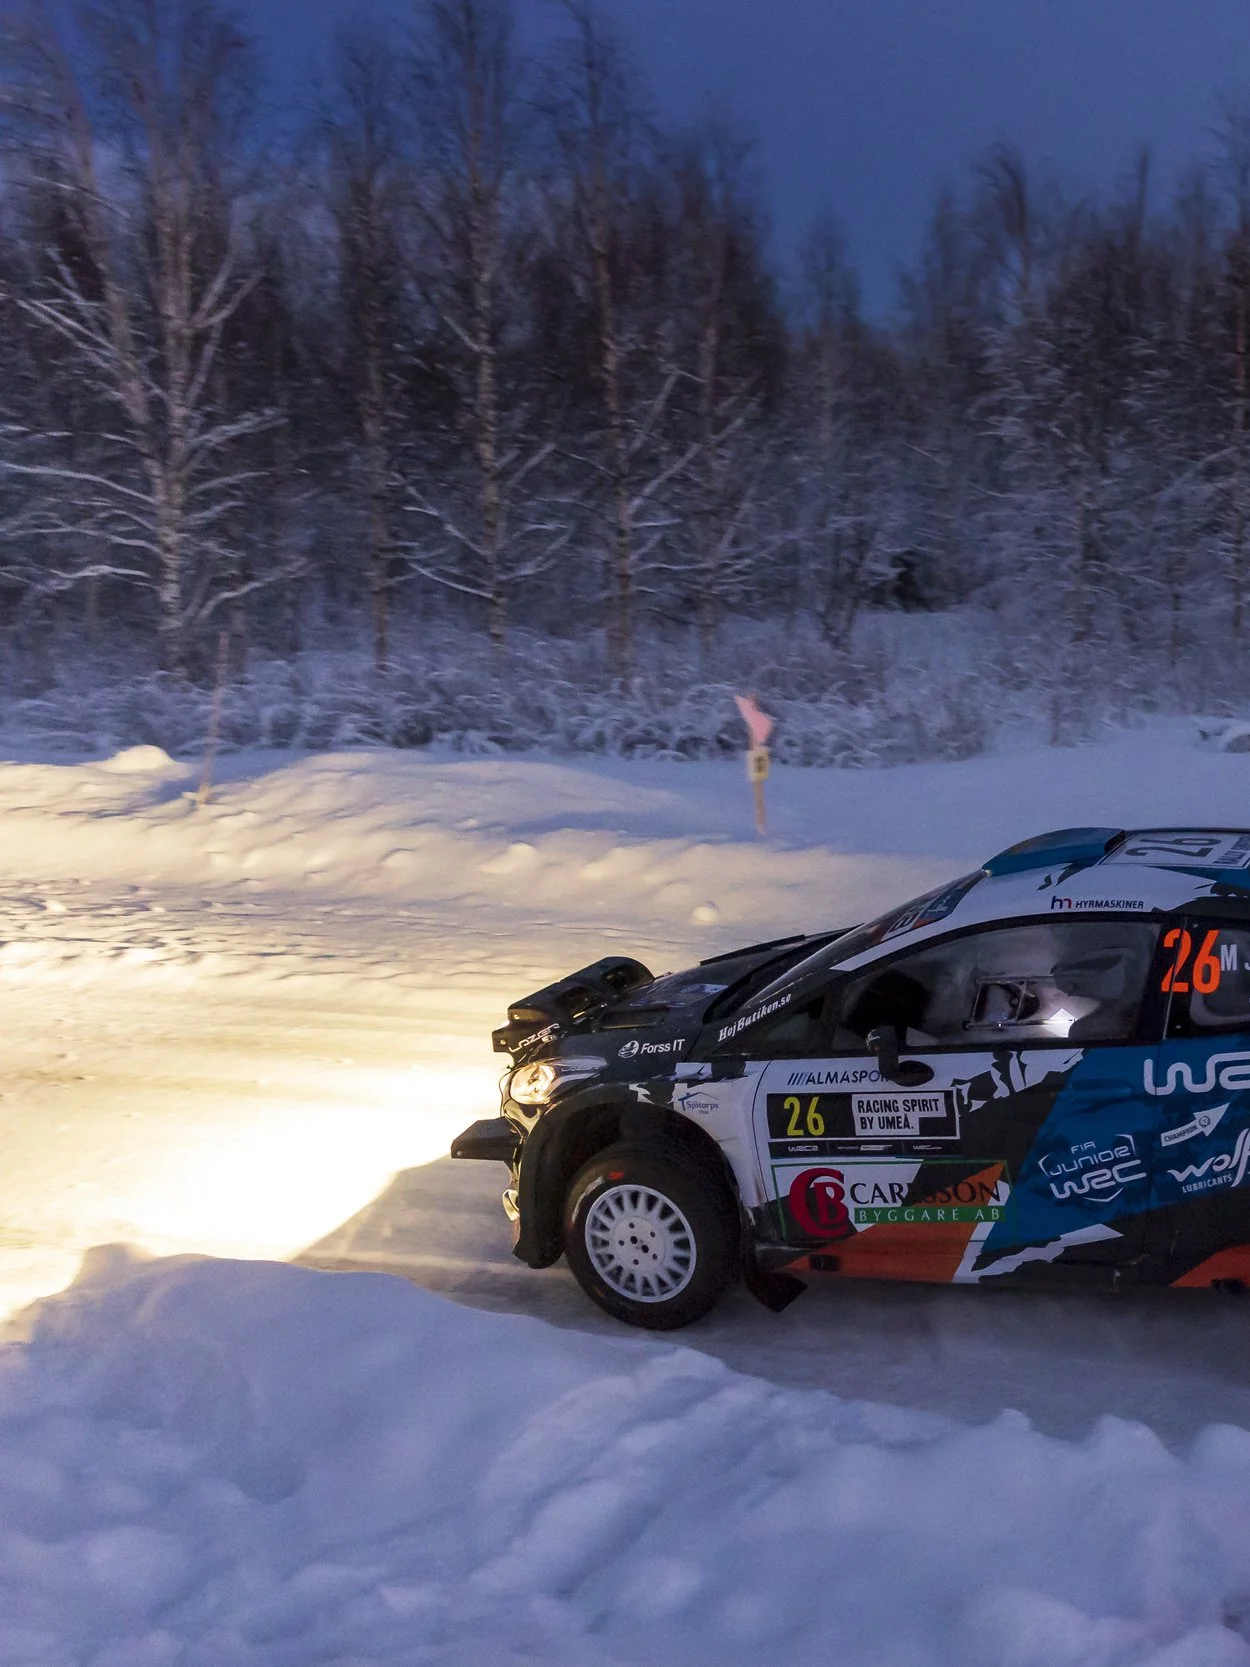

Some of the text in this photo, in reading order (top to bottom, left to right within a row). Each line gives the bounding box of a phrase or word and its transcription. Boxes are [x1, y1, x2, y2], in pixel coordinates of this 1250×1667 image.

[1124, 837, 1222, 857] 26
[1075, 899, 1144, 909] HYRMASKINER
[1160, 928, 1221, 994] 26
[1219, 943, 1238, 972] M
[640, 1038, 686, 1055] Forss IT
[857, 1098, 940, 1114] RACING SPIRIT
[783, 1096, 825, 1137] 26
[860, 1117, 874, 1130] BY
[1163, 1124, 1199, 1143] CHAMPION
[1070, 1140, 1096, 1155] FIA
[1049, 1145, 1132, 1177] JUNIOR
[1049, 1159, 1147, 1199] WRC
[1181, 1173, 1233, 1194] LUBRICANTS
[859, 1207, 1000, 1222] BYGGARE AB
